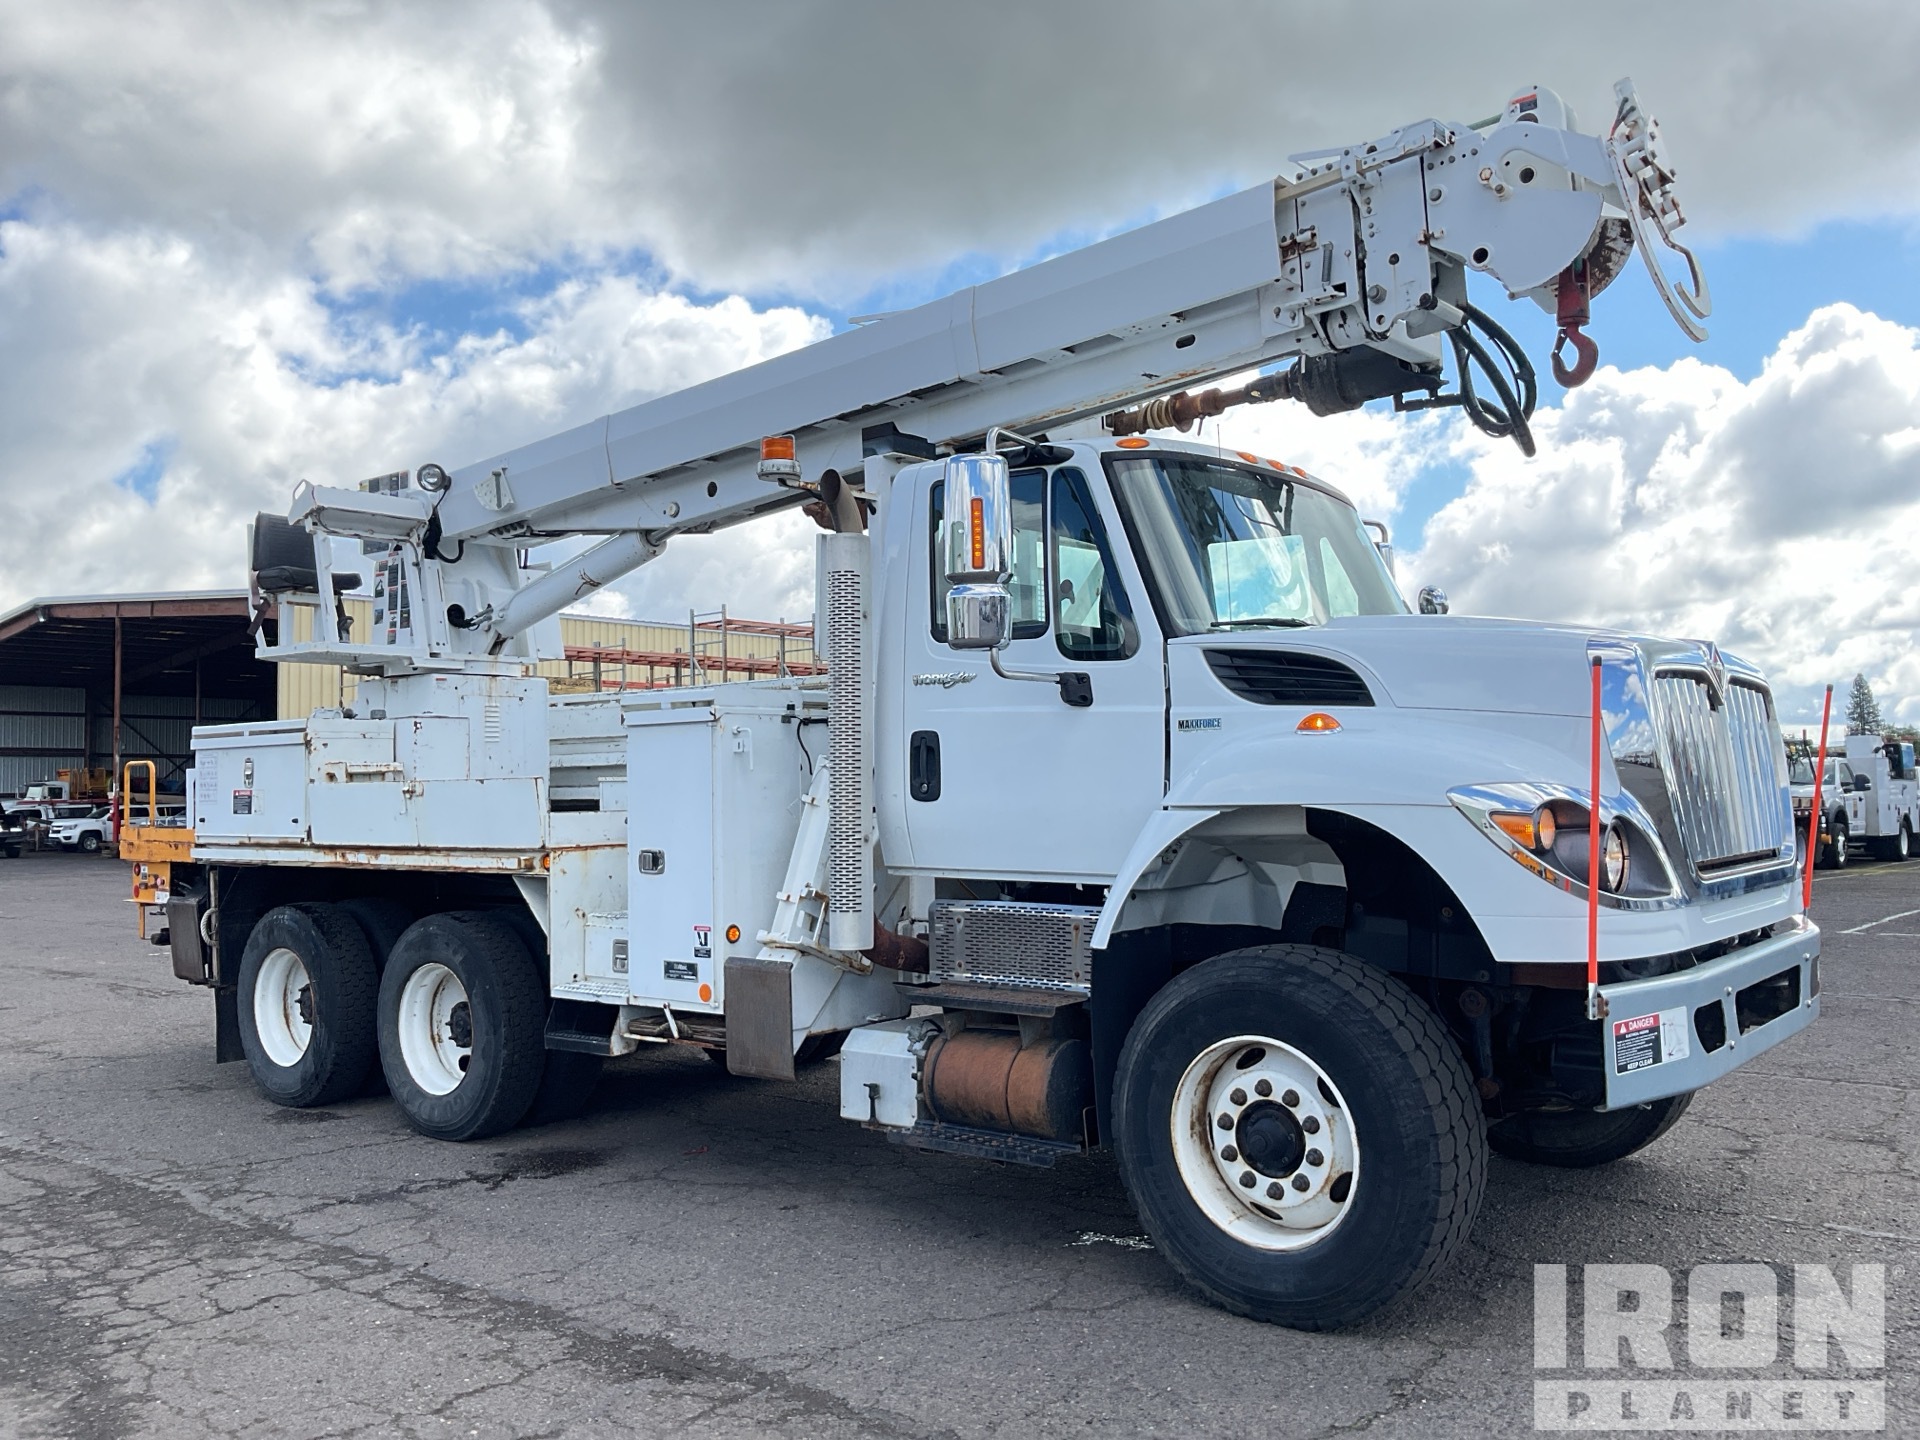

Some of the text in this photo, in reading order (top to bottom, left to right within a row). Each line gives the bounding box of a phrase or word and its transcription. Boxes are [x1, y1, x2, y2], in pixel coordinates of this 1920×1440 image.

[1178, 717, 1222, 730] MAXXFORCE
[1628, 1017, 1654, 1031] DANGER
[1638, 1057, 1653, 1068] CLEAR
